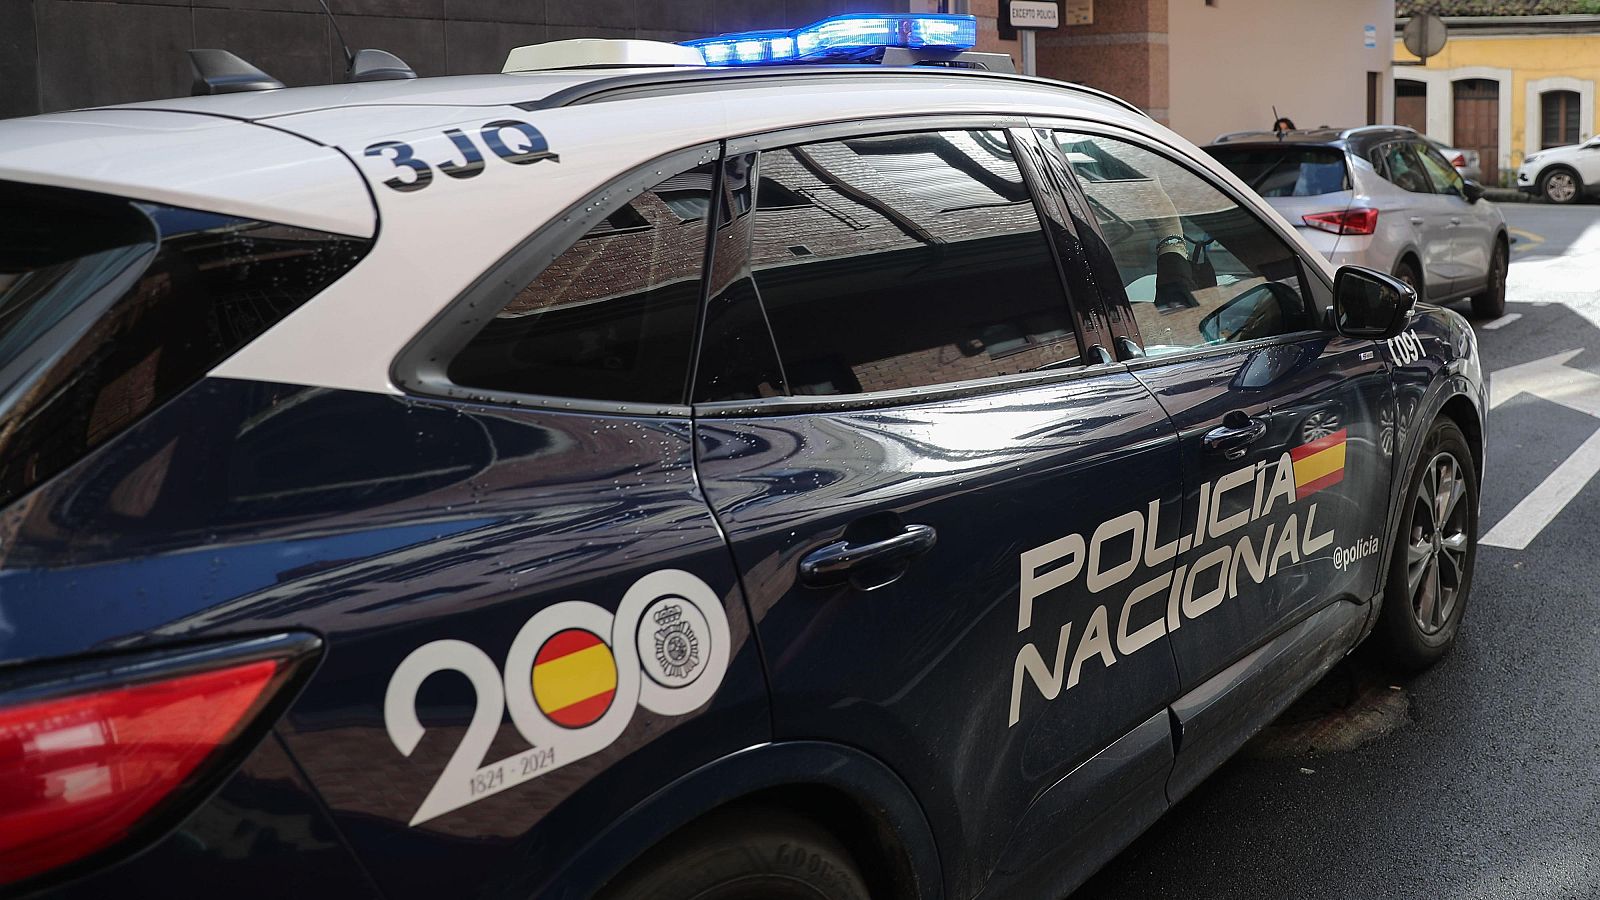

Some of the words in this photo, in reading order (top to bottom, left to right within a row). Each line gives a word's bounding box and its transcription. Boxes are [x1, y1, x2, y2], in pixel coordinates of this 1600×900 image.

[1012, 8, 1035, 19] EXCEPTO
[364, 119, 560, 193] 3JQ
[1008, 503, 1335, 728] NACIONAL
[384, 568, 731, 827] 200
[470, 767, 503, 795] 1824
[521, 746, 554, 776] 2024
